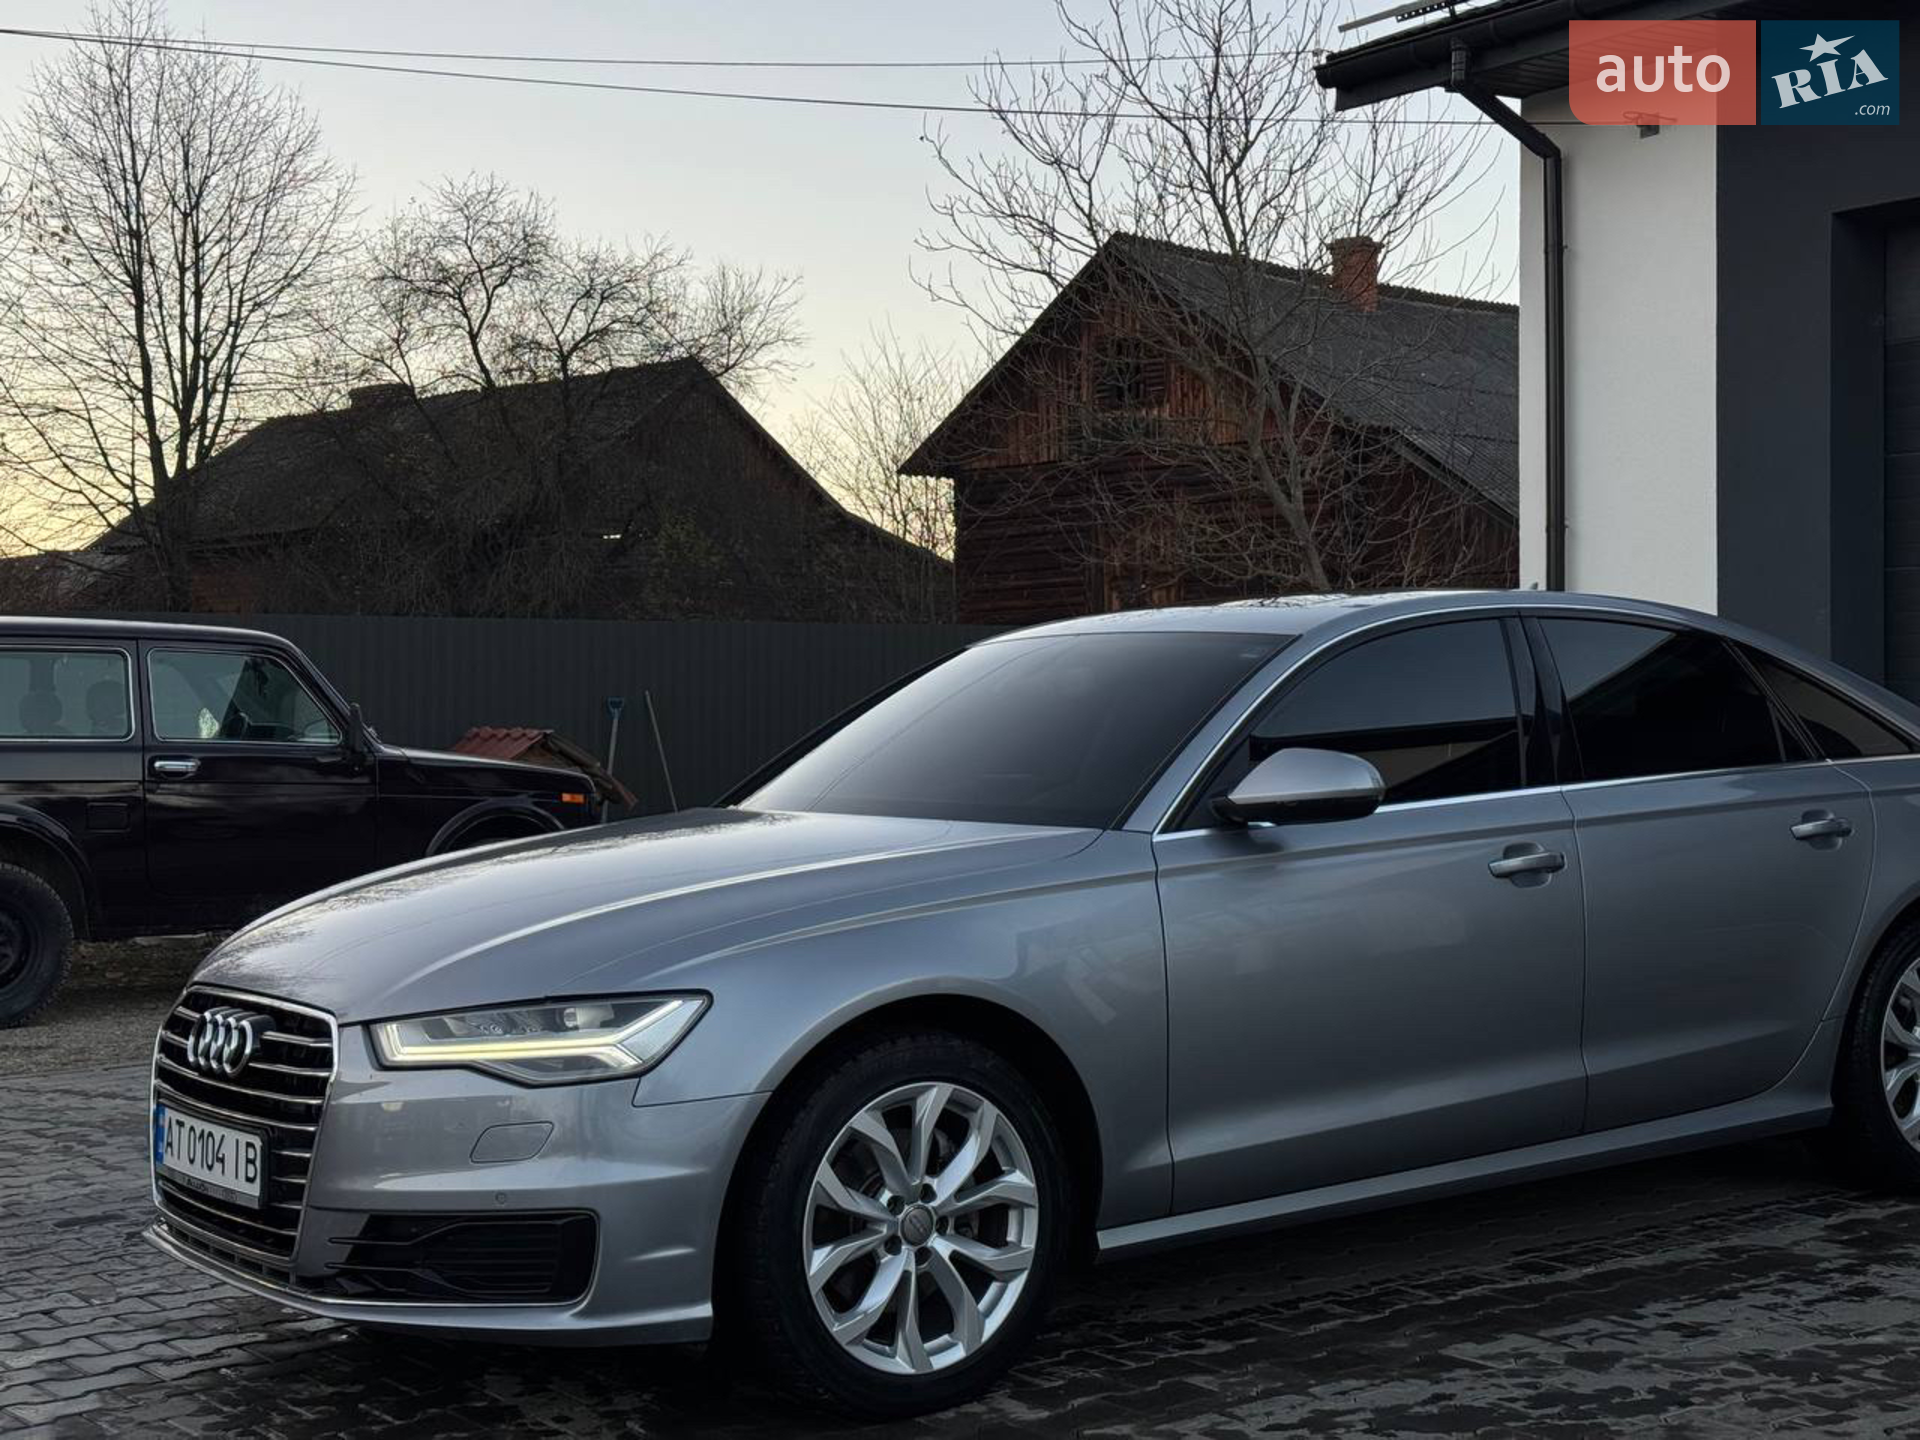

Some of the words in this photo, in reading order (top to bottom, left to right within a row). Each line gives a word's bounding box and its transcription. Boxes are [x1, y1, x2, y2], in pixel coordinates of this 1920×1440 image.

[165, 1116, 185, 1160] AT
[187, 1124, 226, 1176] 0104
[235, 1138, 258, 1184] IB
